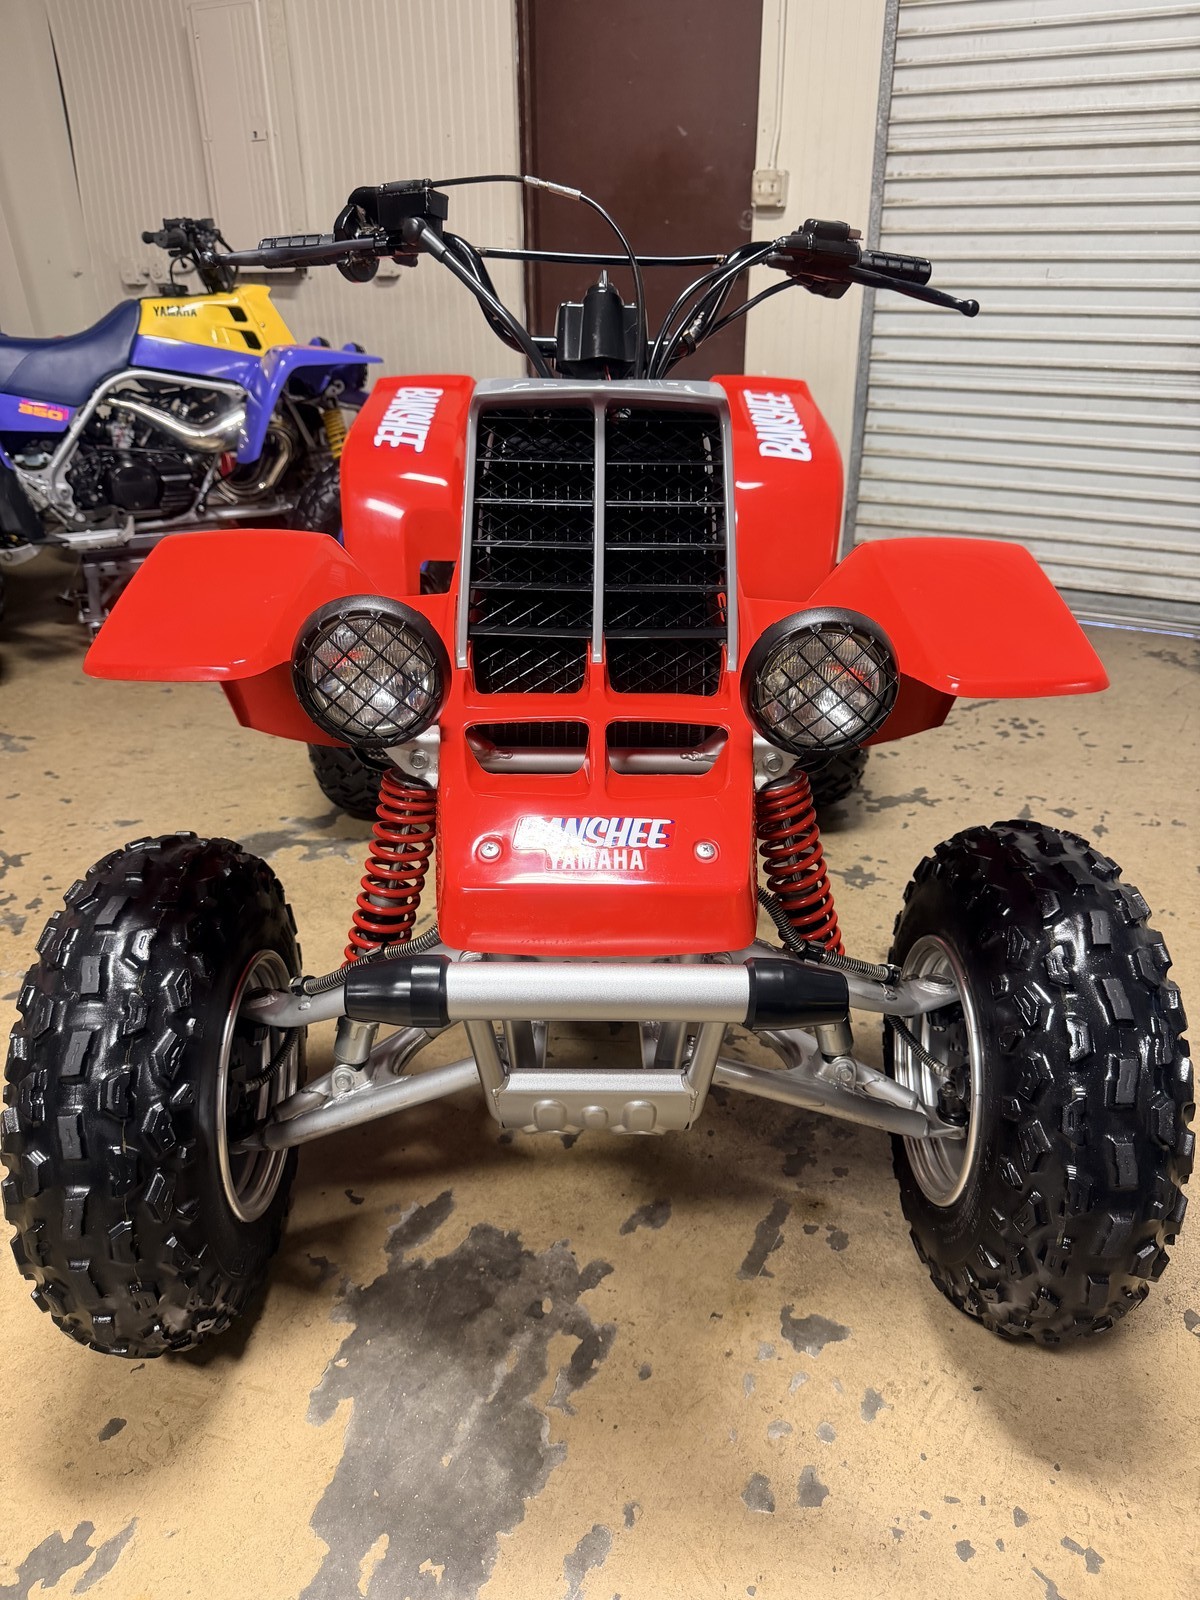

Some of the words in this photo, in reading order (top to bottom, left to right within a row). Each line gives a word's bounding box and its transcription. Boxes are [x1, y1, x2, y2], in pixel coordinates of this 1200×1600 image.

[373, 387, 444, 453] BANSHEE
[743, 389, 812, 462] BANSHEE
[514, 816, 675, 848] NSHEE
[549, 849, 644, 870] YAMAHA
